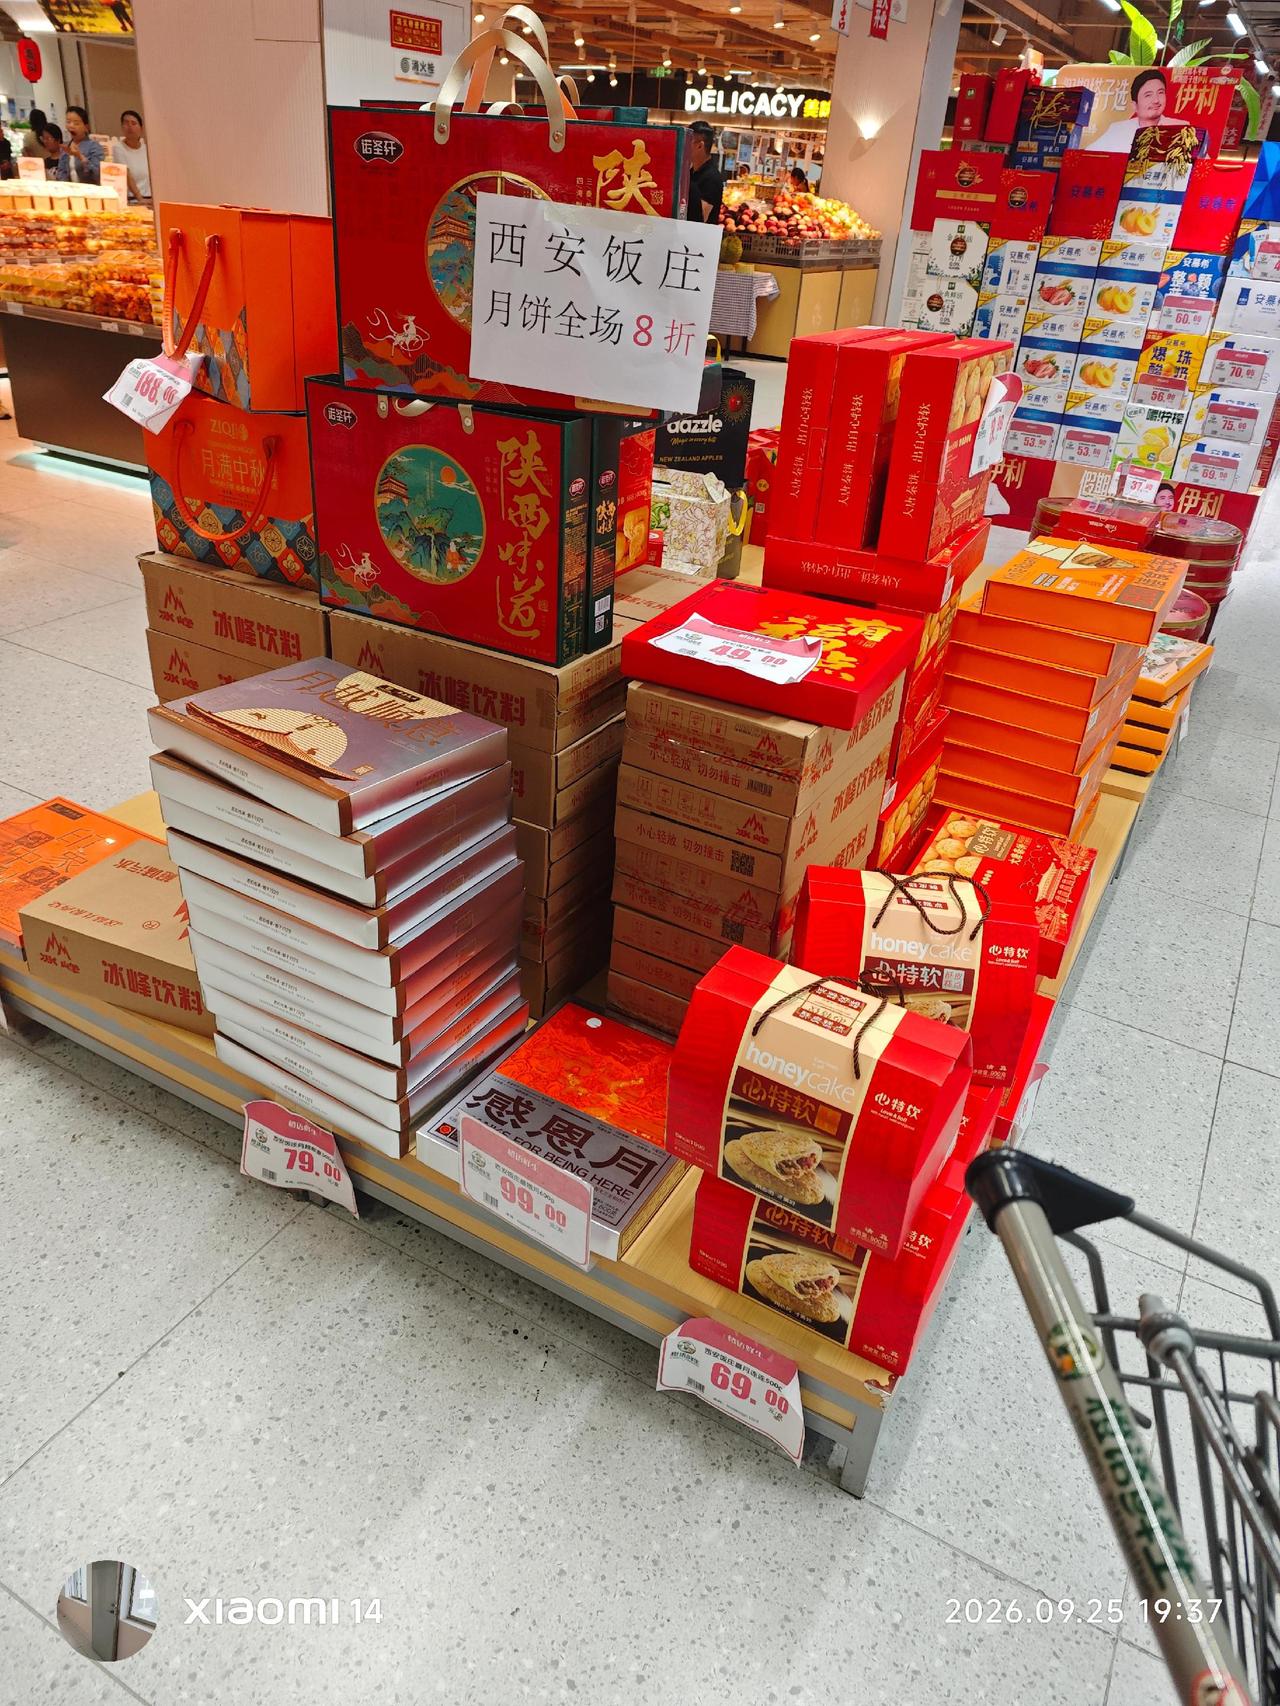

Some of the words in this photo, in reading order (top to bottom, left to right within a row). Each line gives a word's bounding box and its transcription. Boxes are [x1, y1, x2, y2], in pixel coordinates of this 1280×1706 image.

[685, 88, 806, 118] DELICACY
[1174, 84, 1219, 114] 伊利
[488, 220, 705, 293] 西安饭庄
[484, 289, 696, 359] 月饼全场8折
[1178, 487, 1225, 517] 伊利
[212, 608, 303, 661] 冰峰饮料
[418, 669, 525, 727] 冰峰饮料
[636, 823, 677, 848] 小心轻放
[683, 837, 724, 863] 切勿撞击
[871, 932, 973, 962] honeycake
[988, 945, 1030, 961] 心特软
[101, 959, 204, 1016] 冰峰饮料
[745, 1042, 855, 1104] honeycake
[742, 1075, 816, 1126] 心特软
[875, 1091, 922, 1121] 心特软
[466, 1087, 658, 1189] 感恩月
[284, 1148, 342, 1181] 79.00
[513, 1136, 543, 1155] FOR
[543, 1151, 590, 1178] BEING
[590, 1173, 634, 1200] HERE
[500, 1176, 567, 1227] 99.00
[765, 1205, 832, 1250] 心特软
[710, 1362, 789, 1415] 69.00
